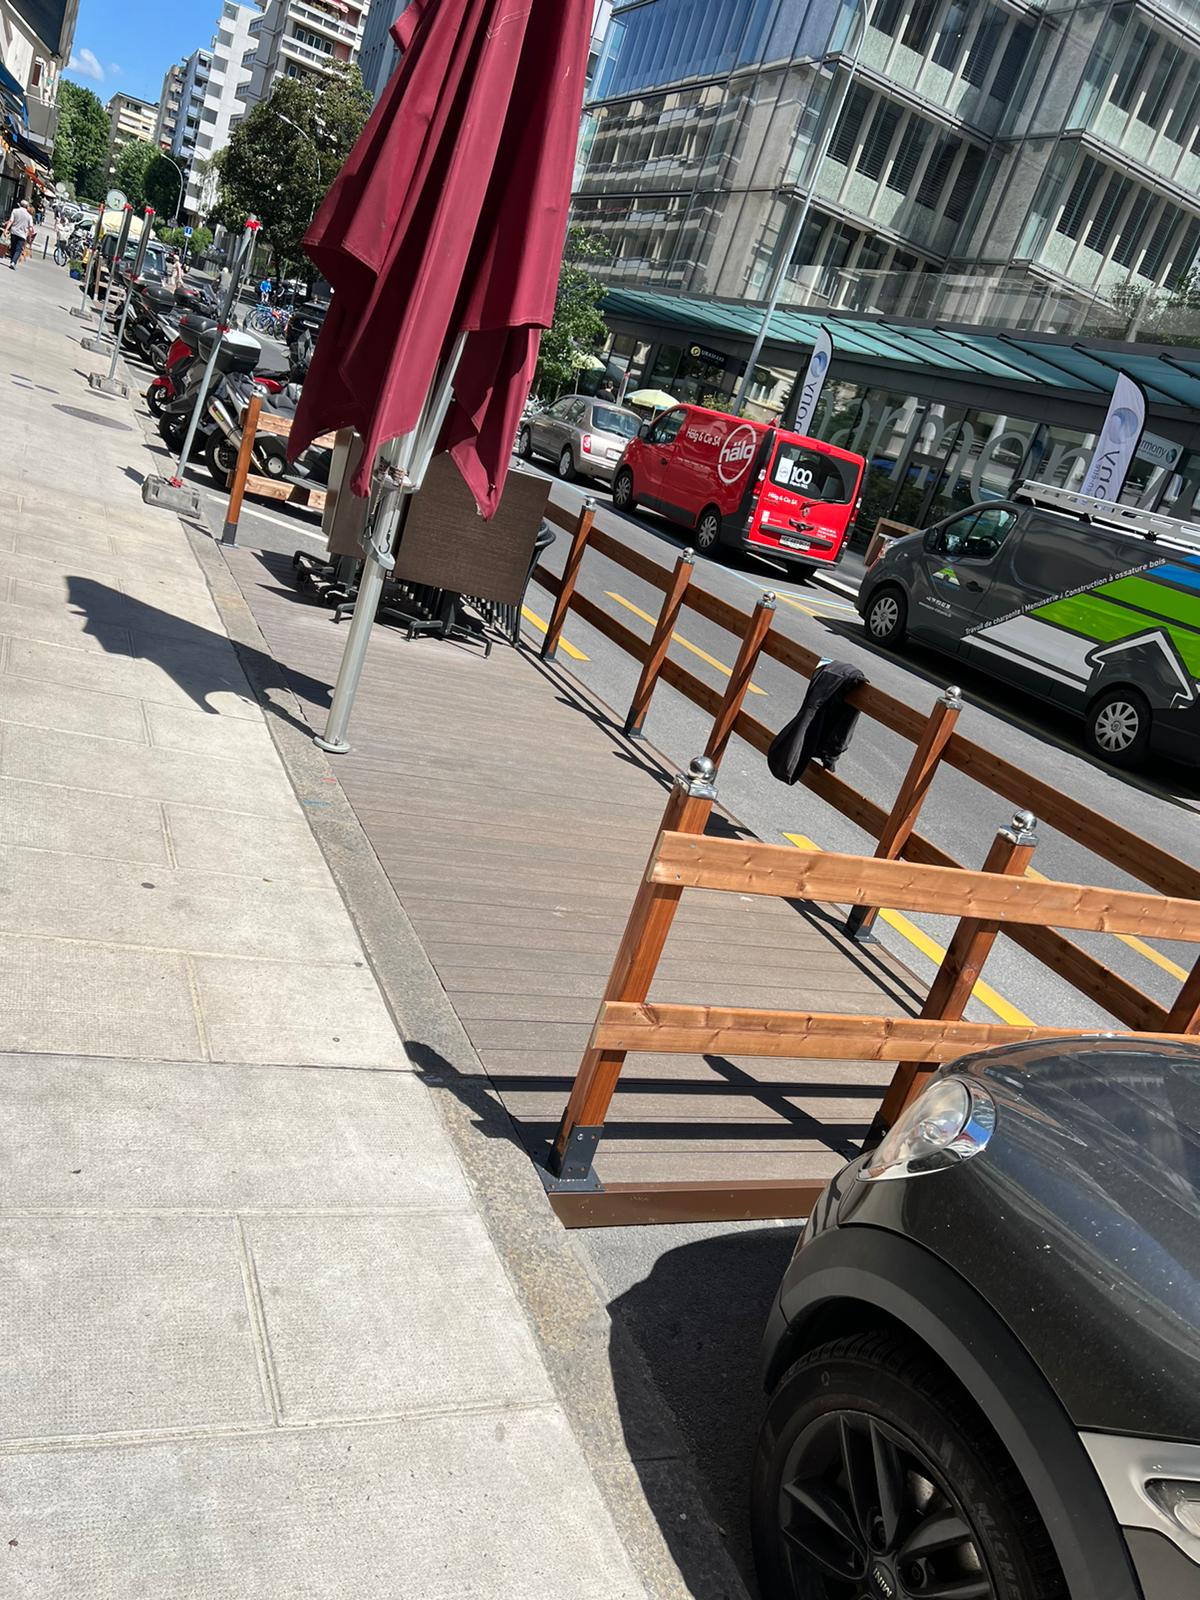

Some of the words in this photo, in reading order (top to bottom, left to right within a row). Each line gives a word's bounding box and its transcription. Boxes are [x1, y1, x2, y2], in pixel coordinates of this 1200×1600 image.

[1140, 440, 1167, 458] rmony
[790, 466, 813, 485] 100
[984, 620, 992, 628] de
[1064, 577, 1107, 598] Construction
[1114, 563, 1148, 580] ossature
[1149, 557, 1166, 569] bois
[873, 1567, 893, 1598] MINI
